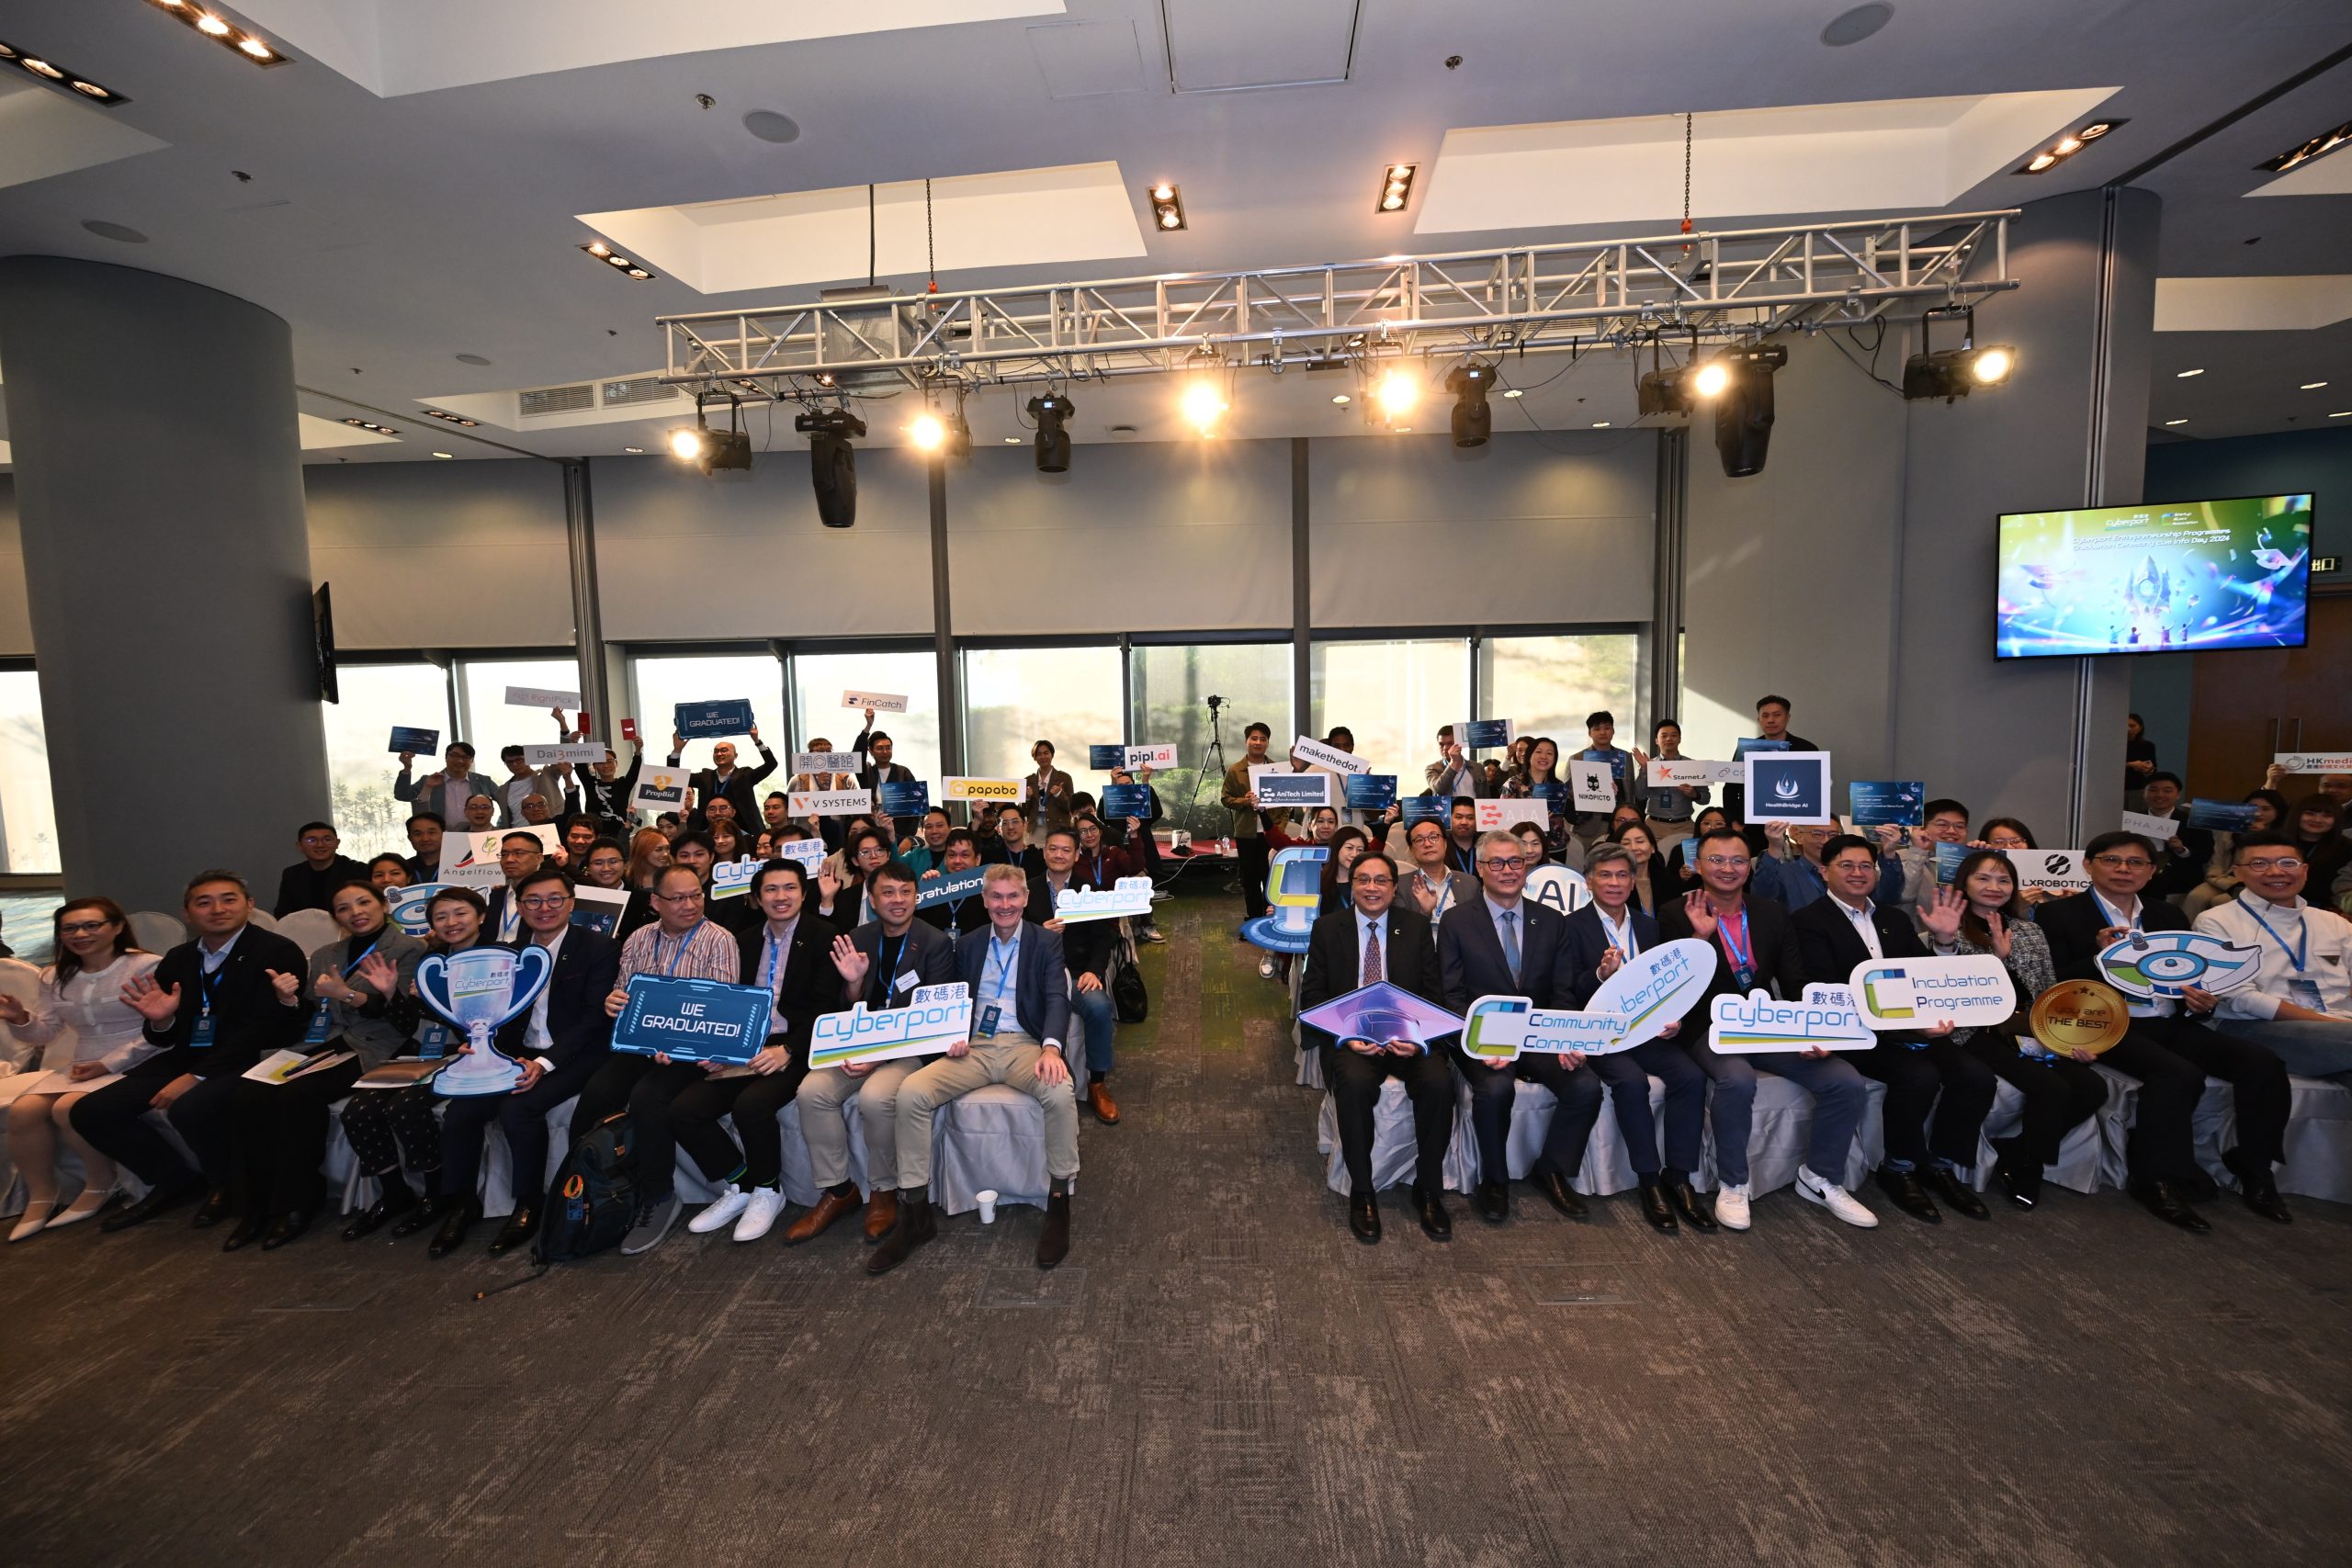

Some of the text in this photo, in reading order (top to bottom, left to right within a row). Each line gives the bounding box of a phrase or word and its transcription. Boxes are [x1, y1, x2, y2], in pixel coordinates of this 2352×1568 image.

[861, 697, 902, 709] FinCatch
[689, 716, 741, 728] GRADUATED!
[537, 749, 594, 761] Dai3mimi
[1130, 749, 1170, 765] pipl.ai
[1299, 744, 1358, 773] makethedot
[645, 789, 675, 798] PropBid
[967, 782, 1018, 795] papabo
[813, 797, 867, 807] V SYSTEMS
[1578, 793, 1611, 802] NIKOPICTO
[785, 841, 820, 855] 數碼港
[443, 868, 503, 876] Angelflow
[1118, 880, 1149, 890] 數碼港
[2022, 879, 2093, 888] LXROBOTICS
[1059, 887, 1150, 911] Cyberport
[1537, 879, 1576, 912] AI
[1650, 947, 1682, 976] 數碼港
[455, 976, 509, 990] Cyberport
[1607, 957, 1689, 1014] berport
[1912, 974, 1999, 989] Incubation
[914, 984, 967, 1004] 數碼港
[1917, 993, 2003, 1010] Programme
[681, 1002, 707, 1017] WE
[641, 1014, 741, 1038] GRADUATED!
[816, 999, 971, 1042] Cyberport
[1529, 1013, 1628, 1034] Community
[2048, 1016, 2110, 1030] THE BEST
[1524, 1034, 1605, 1052] Connect
